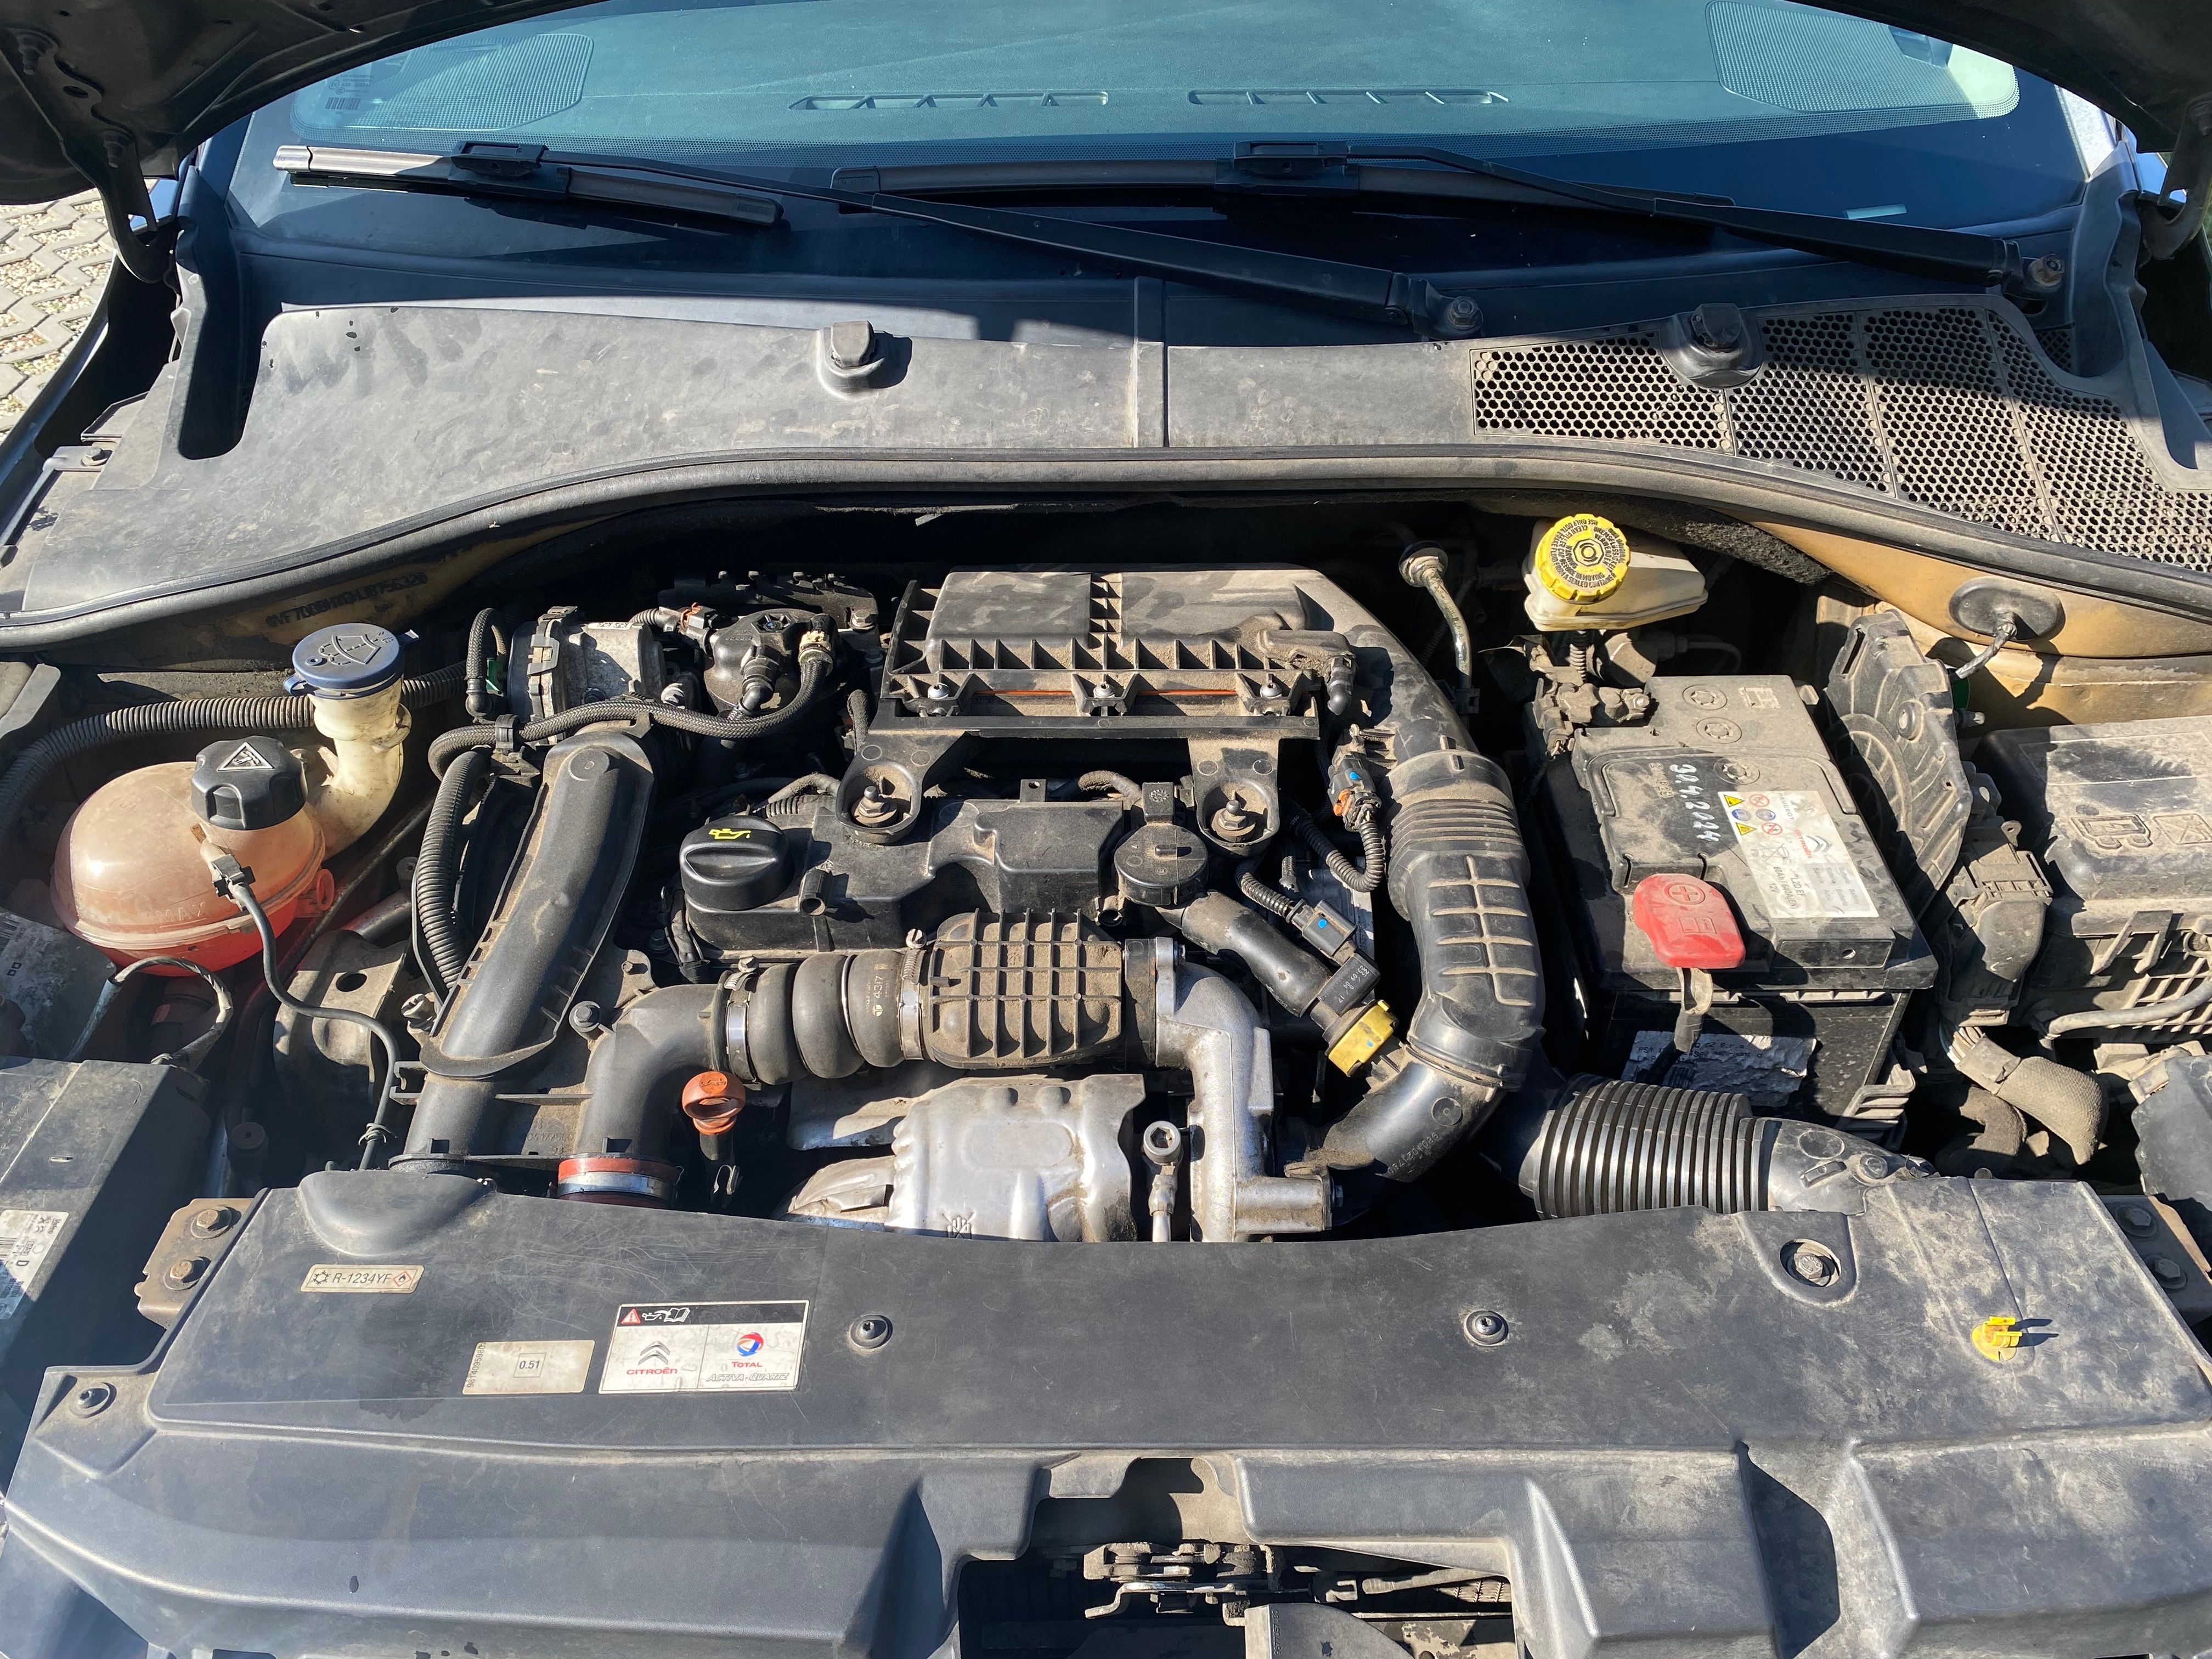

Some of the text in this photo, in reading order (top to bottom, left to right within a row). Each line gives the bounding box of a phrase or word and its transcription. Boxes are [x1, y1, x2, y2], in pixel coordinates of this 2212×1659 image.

[1572, 525, 1588, 534] CLEAN
[1551, 531, 1562, 547] BRAKE
[1778, 793, 1795, 821] PEUGEOT
[332, 1273, 393, 1284] R-1234YF
[519, 1361, 540, 1369] 0.51
